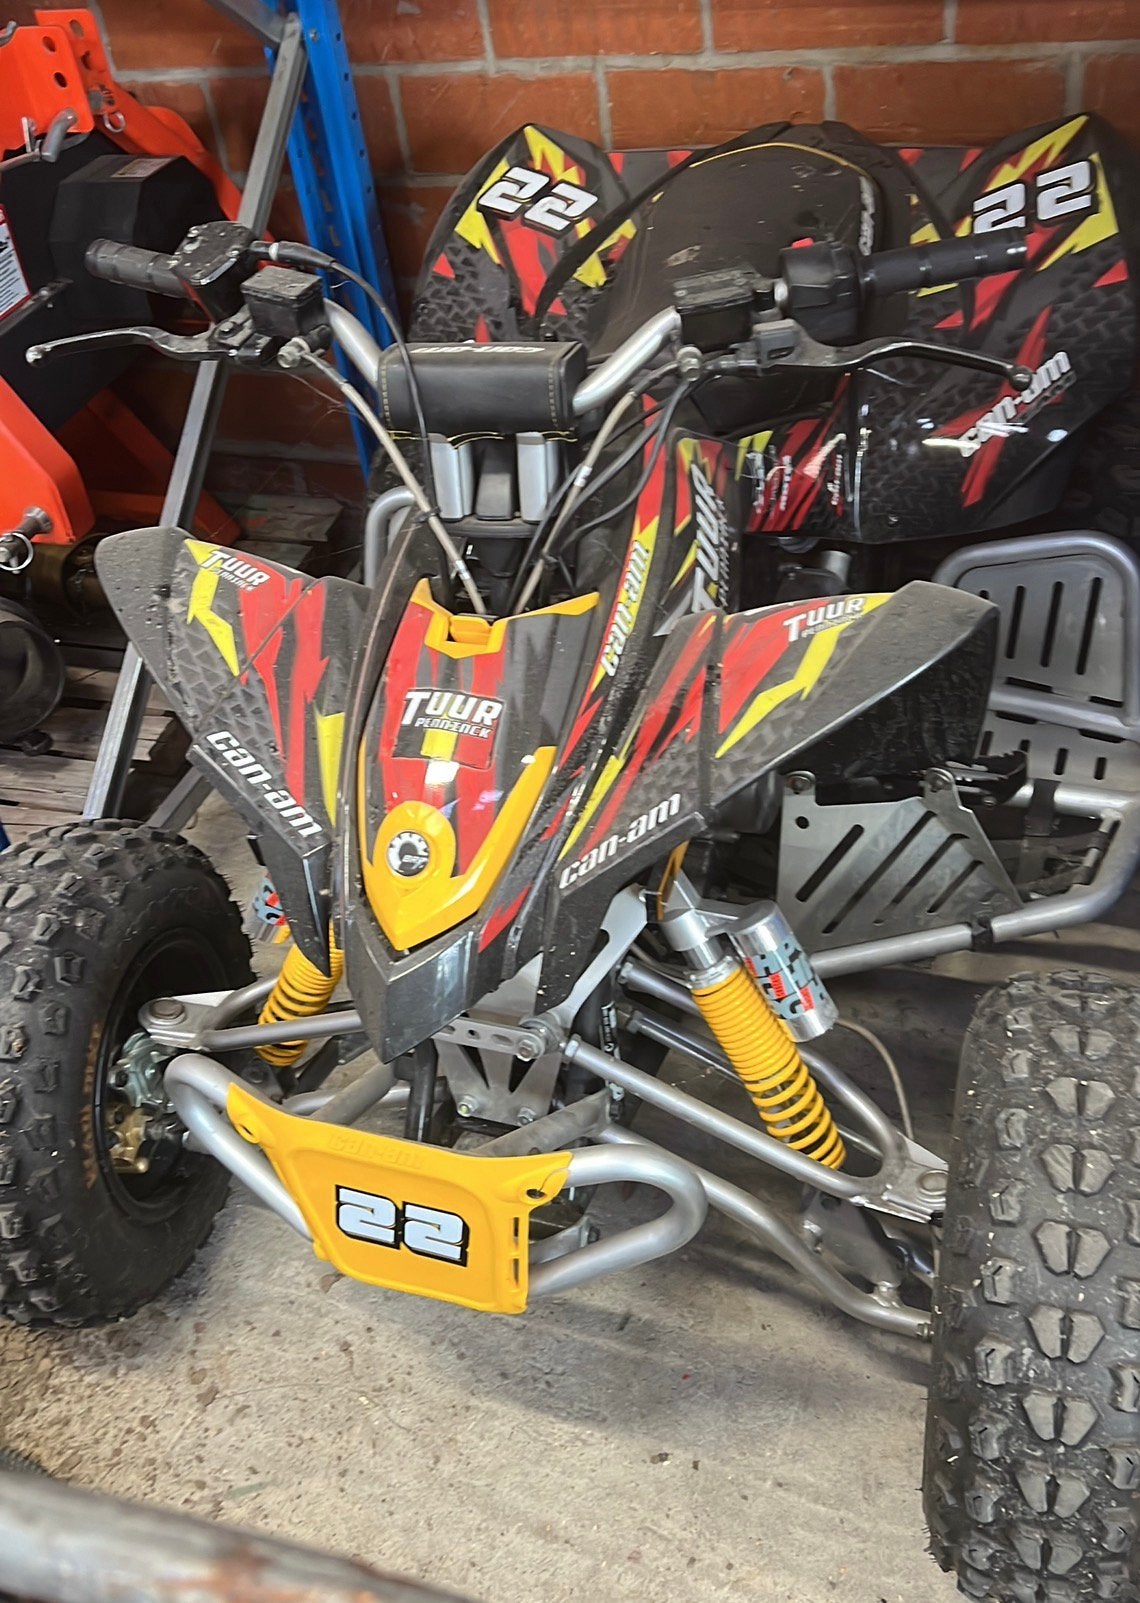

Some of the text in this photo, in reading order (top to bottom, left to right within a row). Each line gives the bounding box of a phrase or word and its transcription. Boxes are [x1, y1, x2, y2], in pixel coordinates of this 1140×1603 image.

[477, 165, 599, 234] 22
[971, 159, 1093, 234] 22
[200, 550, 272, 586] TUUR
[600, 539, 650, 677] can-am
[783, 597, 866, 642] TUUR
[400, 691, 503, 726] TUUR
[206, 731, 323, 837] can-am
[558, 793, 682, 889] can-am
[335, 1184, 469, 1267] 22
